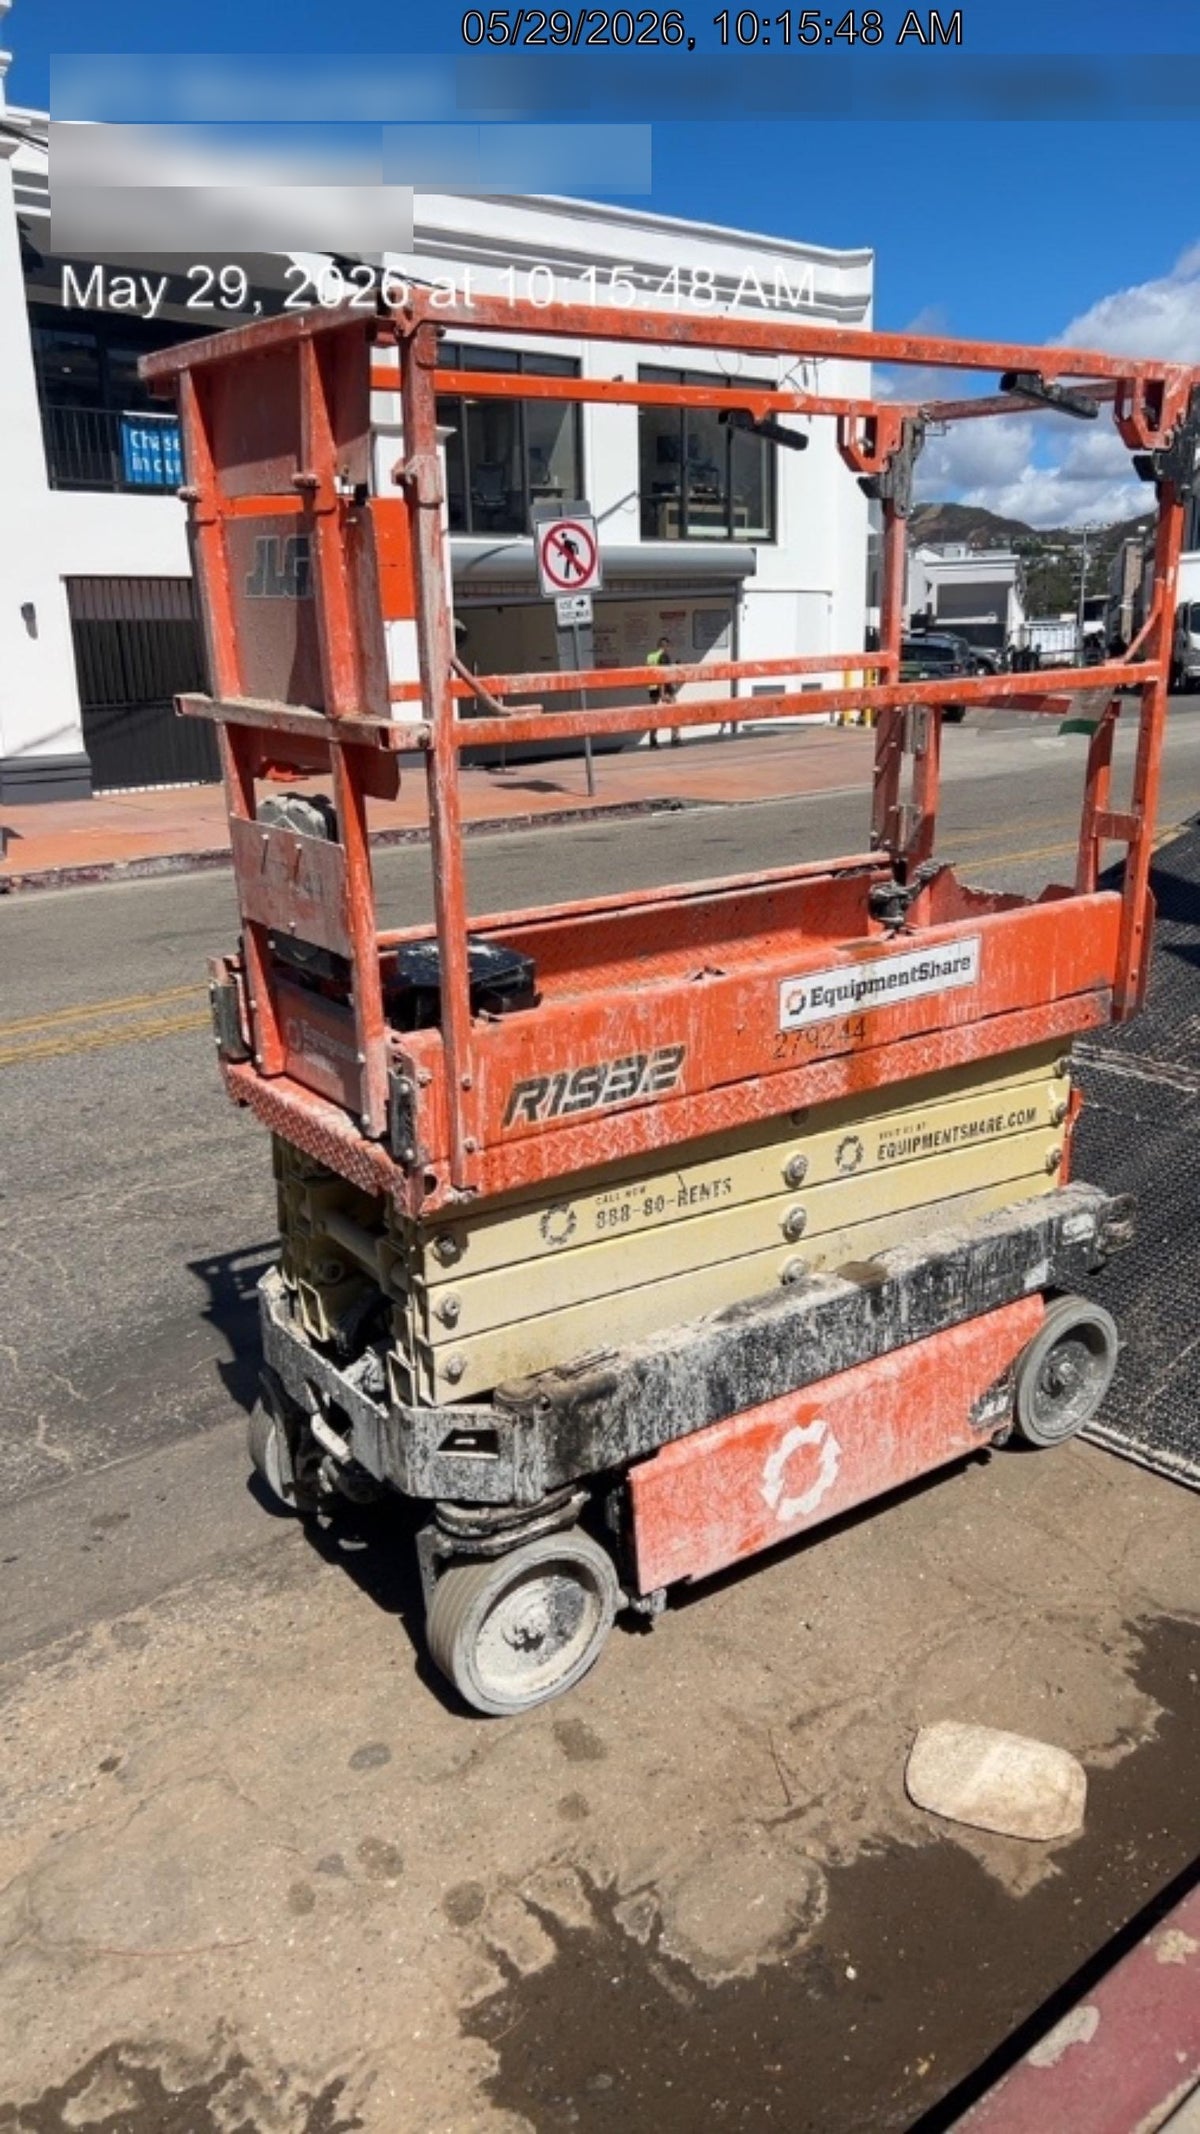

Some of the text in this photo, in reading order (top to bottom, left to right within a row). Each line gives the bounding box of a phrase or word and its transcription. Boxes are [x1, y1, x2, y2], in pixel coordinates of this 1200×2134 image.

[244, 534, 314, 598] JLG
[810, 956, 971, 1008] EquipmentShare
[500, 1043, 687, 1128] R1932
[877, 1107, 1037, 1160] EQUIPMENTSHARE.COM
[596, 1178, 732, 1228] 888-80-RENTS
